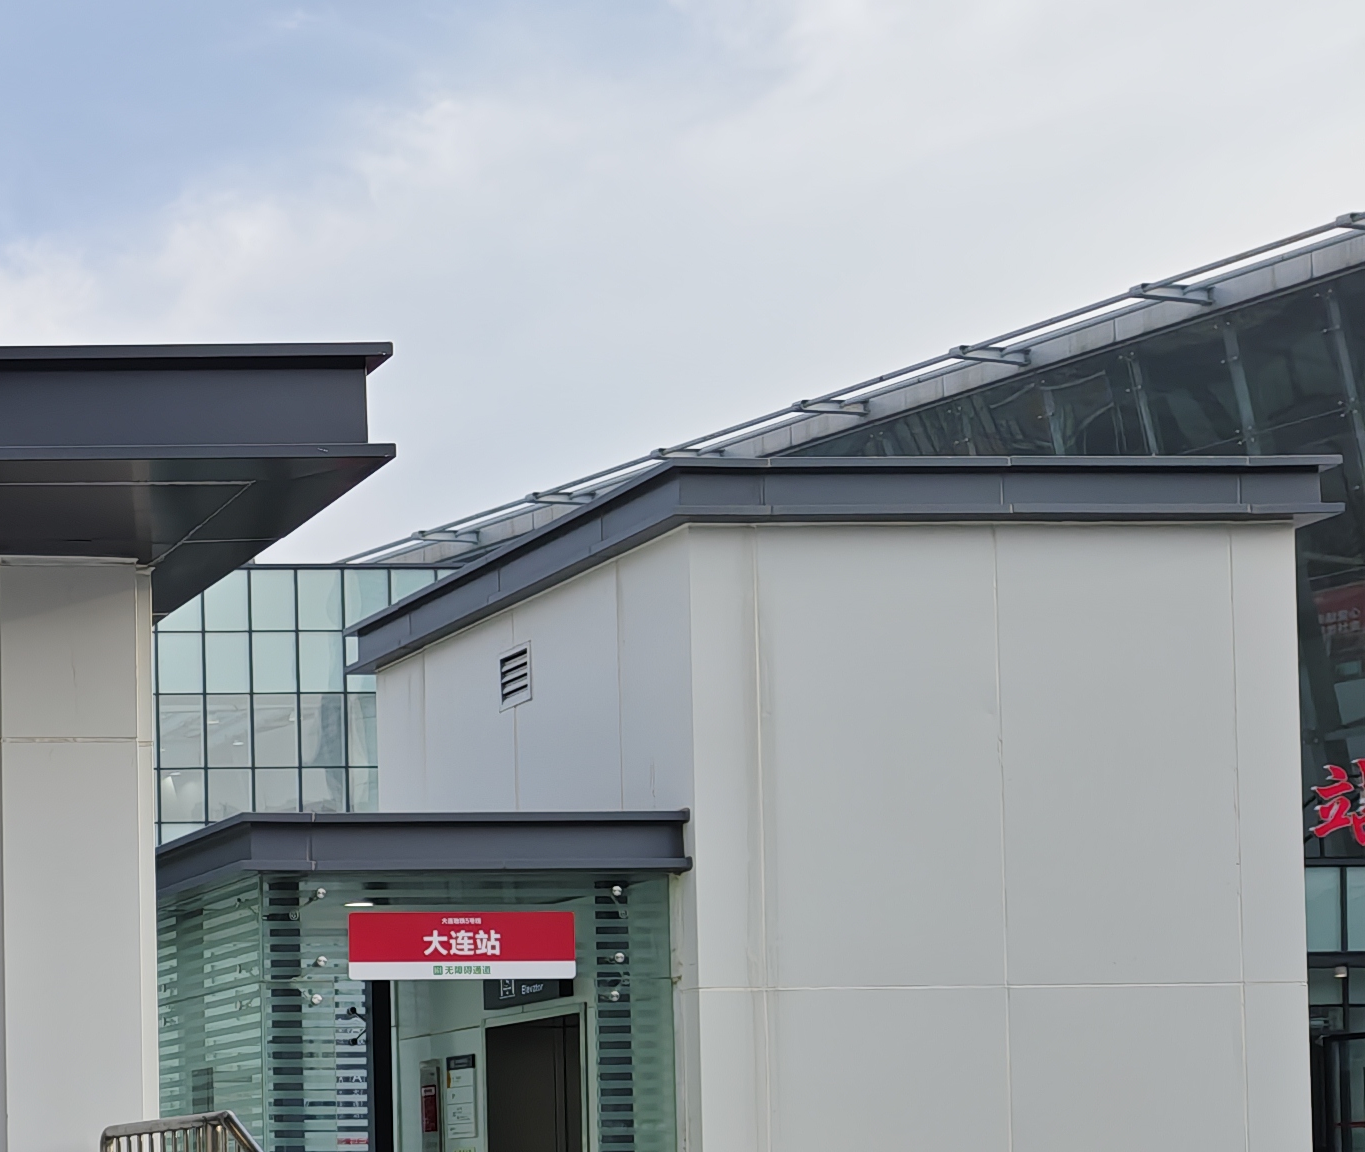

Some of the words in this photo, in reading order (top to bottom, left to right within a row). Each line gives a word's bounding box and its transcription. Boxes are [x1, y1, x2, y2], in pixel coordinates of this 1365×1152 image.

[423, 929, 501, 956] 大连站
[445, 965, 491, 975] 无障碍通道
